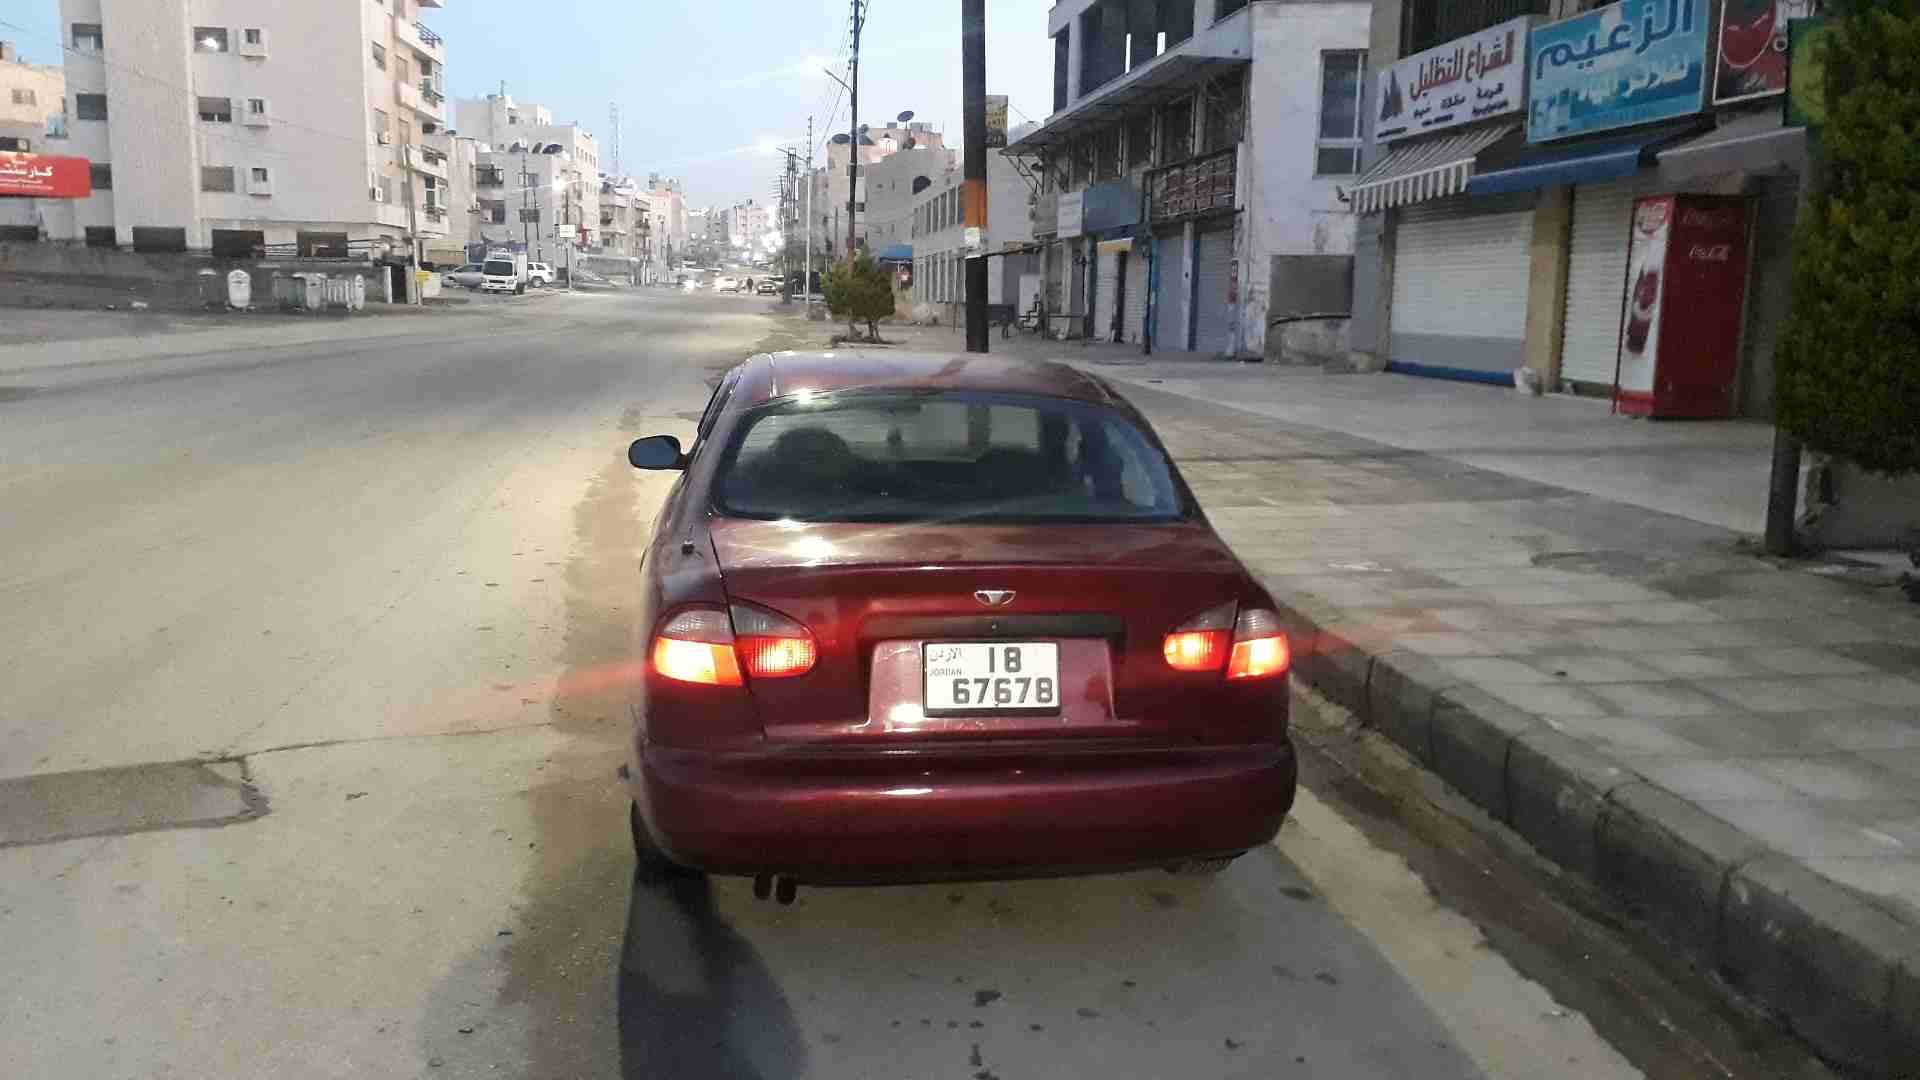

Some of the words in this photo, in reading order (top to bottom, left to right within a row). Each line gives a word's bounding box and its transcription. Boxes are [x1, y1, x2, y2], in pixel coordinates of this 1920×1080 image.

[1536, 0, 1694, 80] الزعيم
[929, 667, 962, 677] JORDAN
[988, 646, 1021, 673] 18
[952, 677, 1053, 704] 67678
